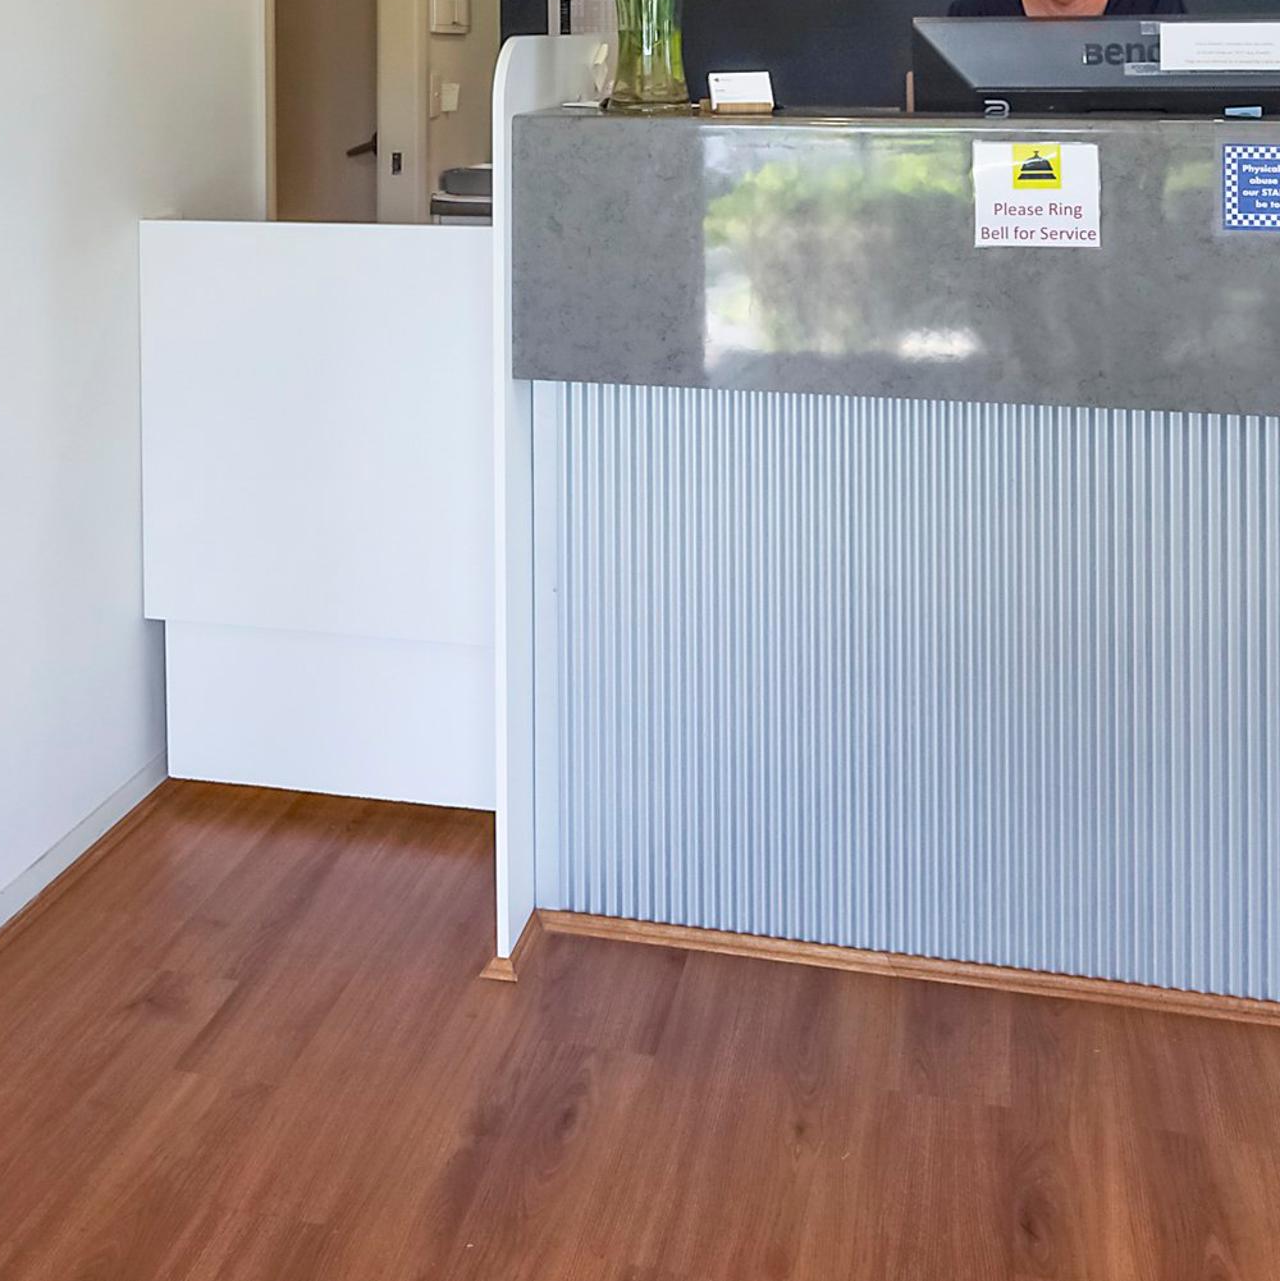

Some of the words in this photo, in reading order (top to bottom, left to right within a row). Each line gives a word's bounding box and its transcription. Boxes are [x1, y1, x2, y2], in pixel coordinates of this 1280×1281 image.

[1242, 164, 1280, 174] Physical
[1249, 176, 1278, 185] abuse
[1255, 199, 1268, 208] be
[993, 202, 1043, 216] Please
[1048, 202, 1083, 220] Ring
[981, 226, 1009, 240] Bell
[1013, 226, 1036, 240] for
[1040, 226, 1097, 241] Service
